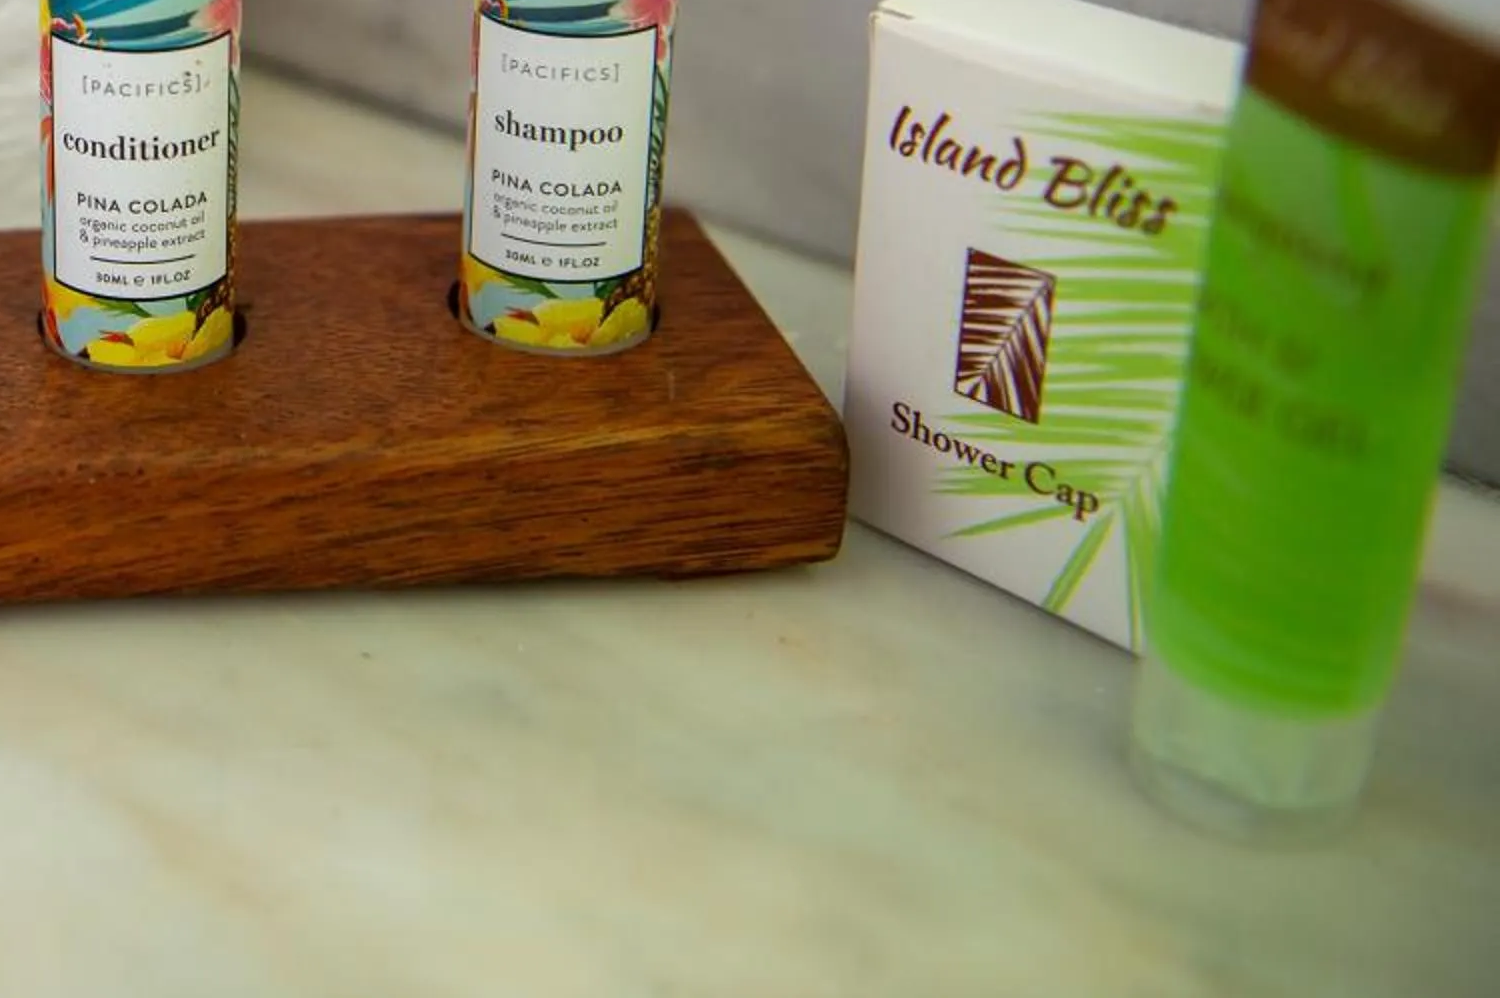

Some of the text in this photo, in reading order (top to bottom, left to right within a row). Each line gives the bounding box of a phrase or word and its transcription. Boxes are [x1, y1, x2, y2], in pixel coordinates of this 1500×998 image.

[495, 110, 623, 151] shampoo
[64, 129, 220, 161] conditioner
[491, 170, 622, 197] PINA COLADA
[888, 105, 1178, 238] Island Bliss
[77, 192, 207, 215] PINA COLADA
[494, 192, 618, 215] organic coconut oil
[80, 211, 204, 233] organic coconut oil
[493, 206, 618, 234] & pineapple extract
[80, 229, 205, 253] & pineapple extract
[890, 401, 1099, 523] Shower Cap
